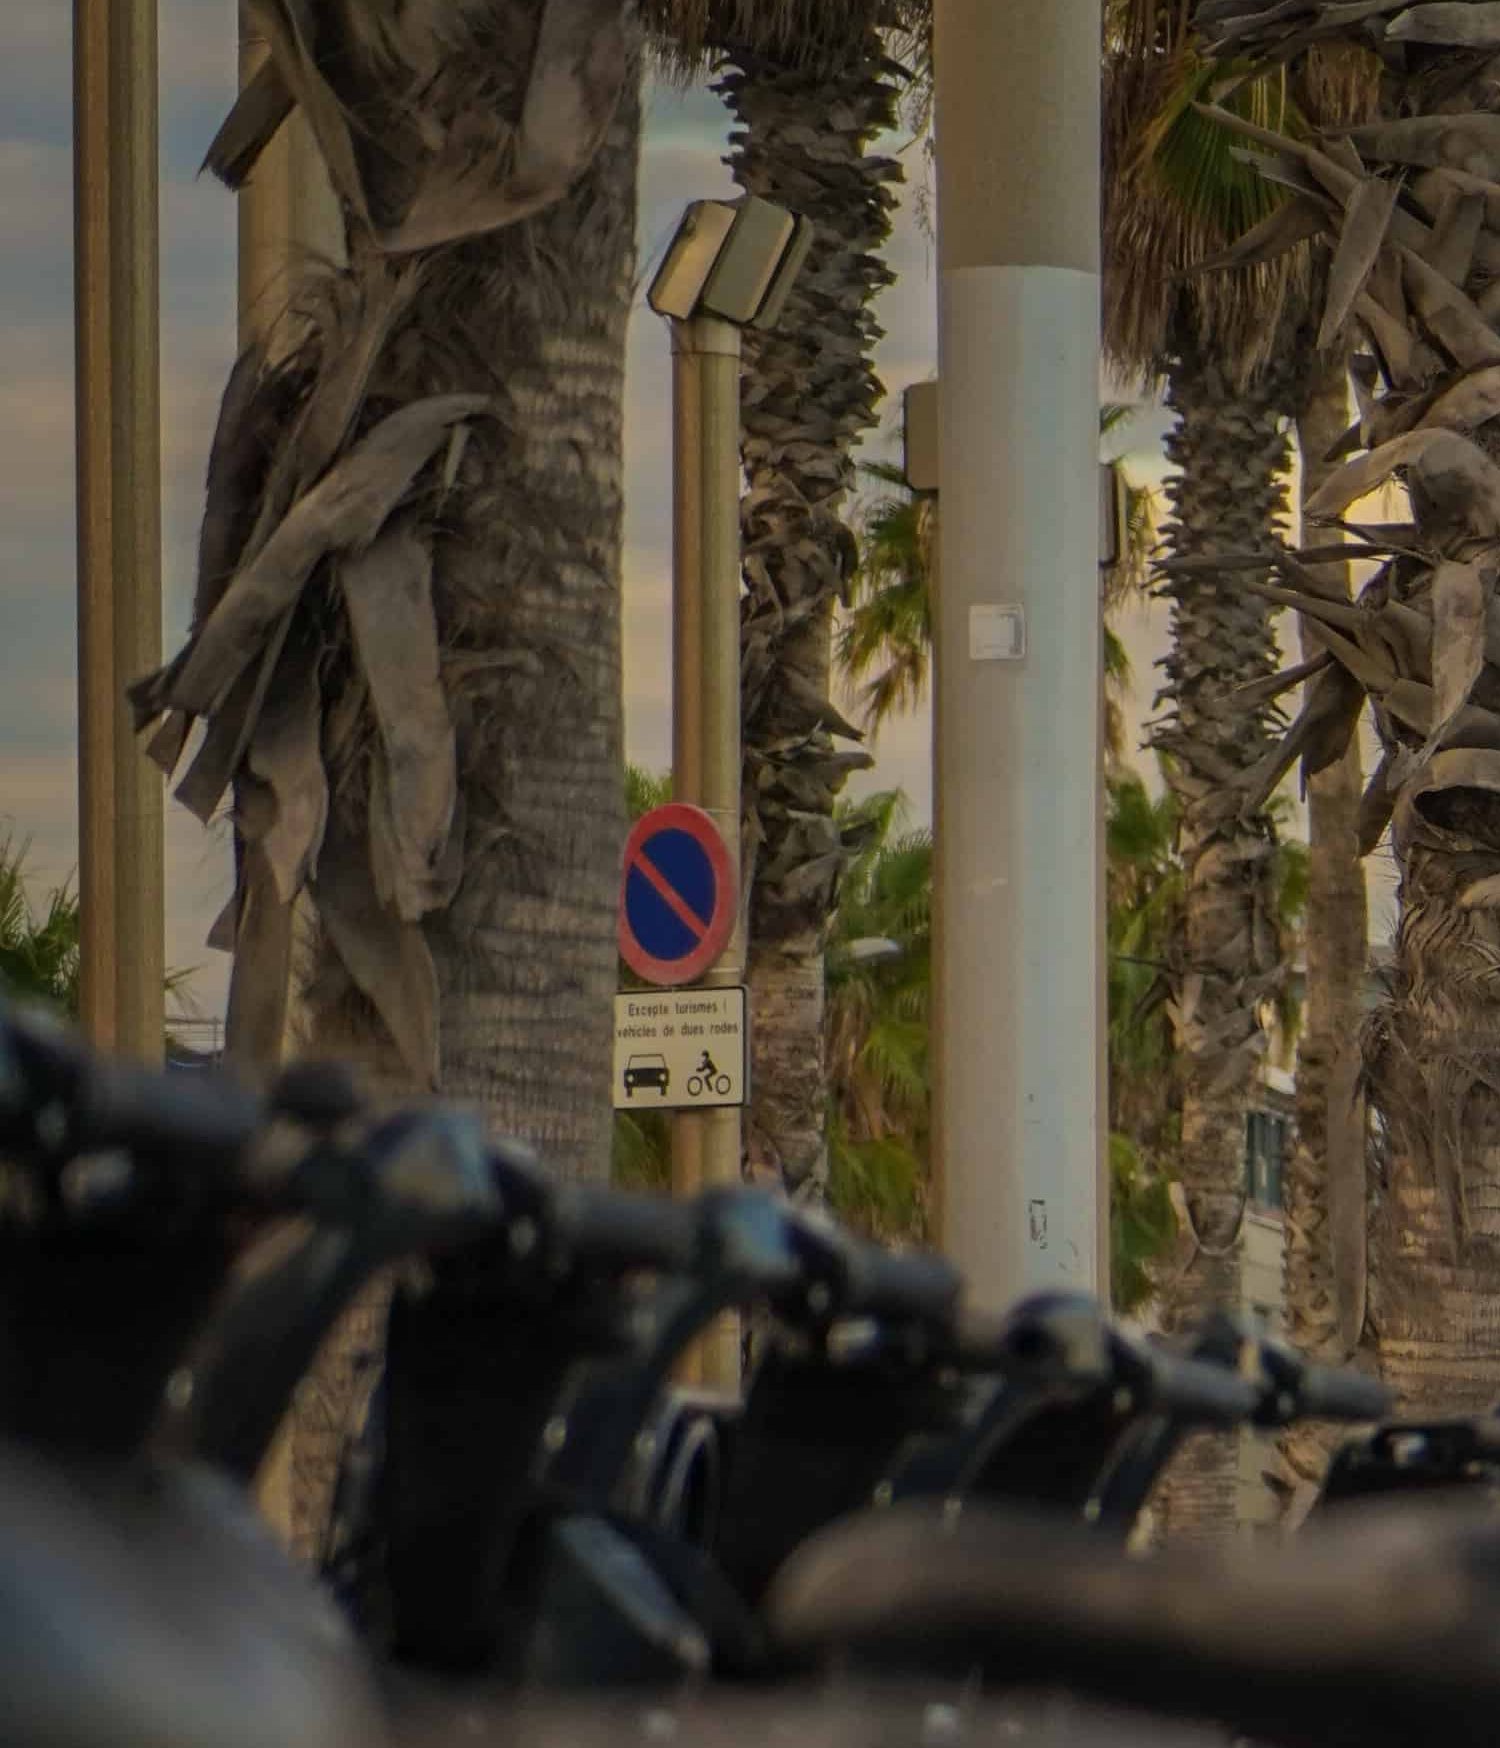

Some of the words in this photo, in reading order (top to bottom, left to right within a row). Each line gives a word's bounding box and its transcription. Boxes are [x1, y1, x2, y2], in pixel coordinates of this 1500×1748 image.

[628, 1003, 669, 1017] Excepte
[675, 1001, 718, 1014] turismes
[617, 1024, 656, 1038] vehicles
[680, 1021, 704, 1036] dues
[710, 1020, 738, 1035] rodes
